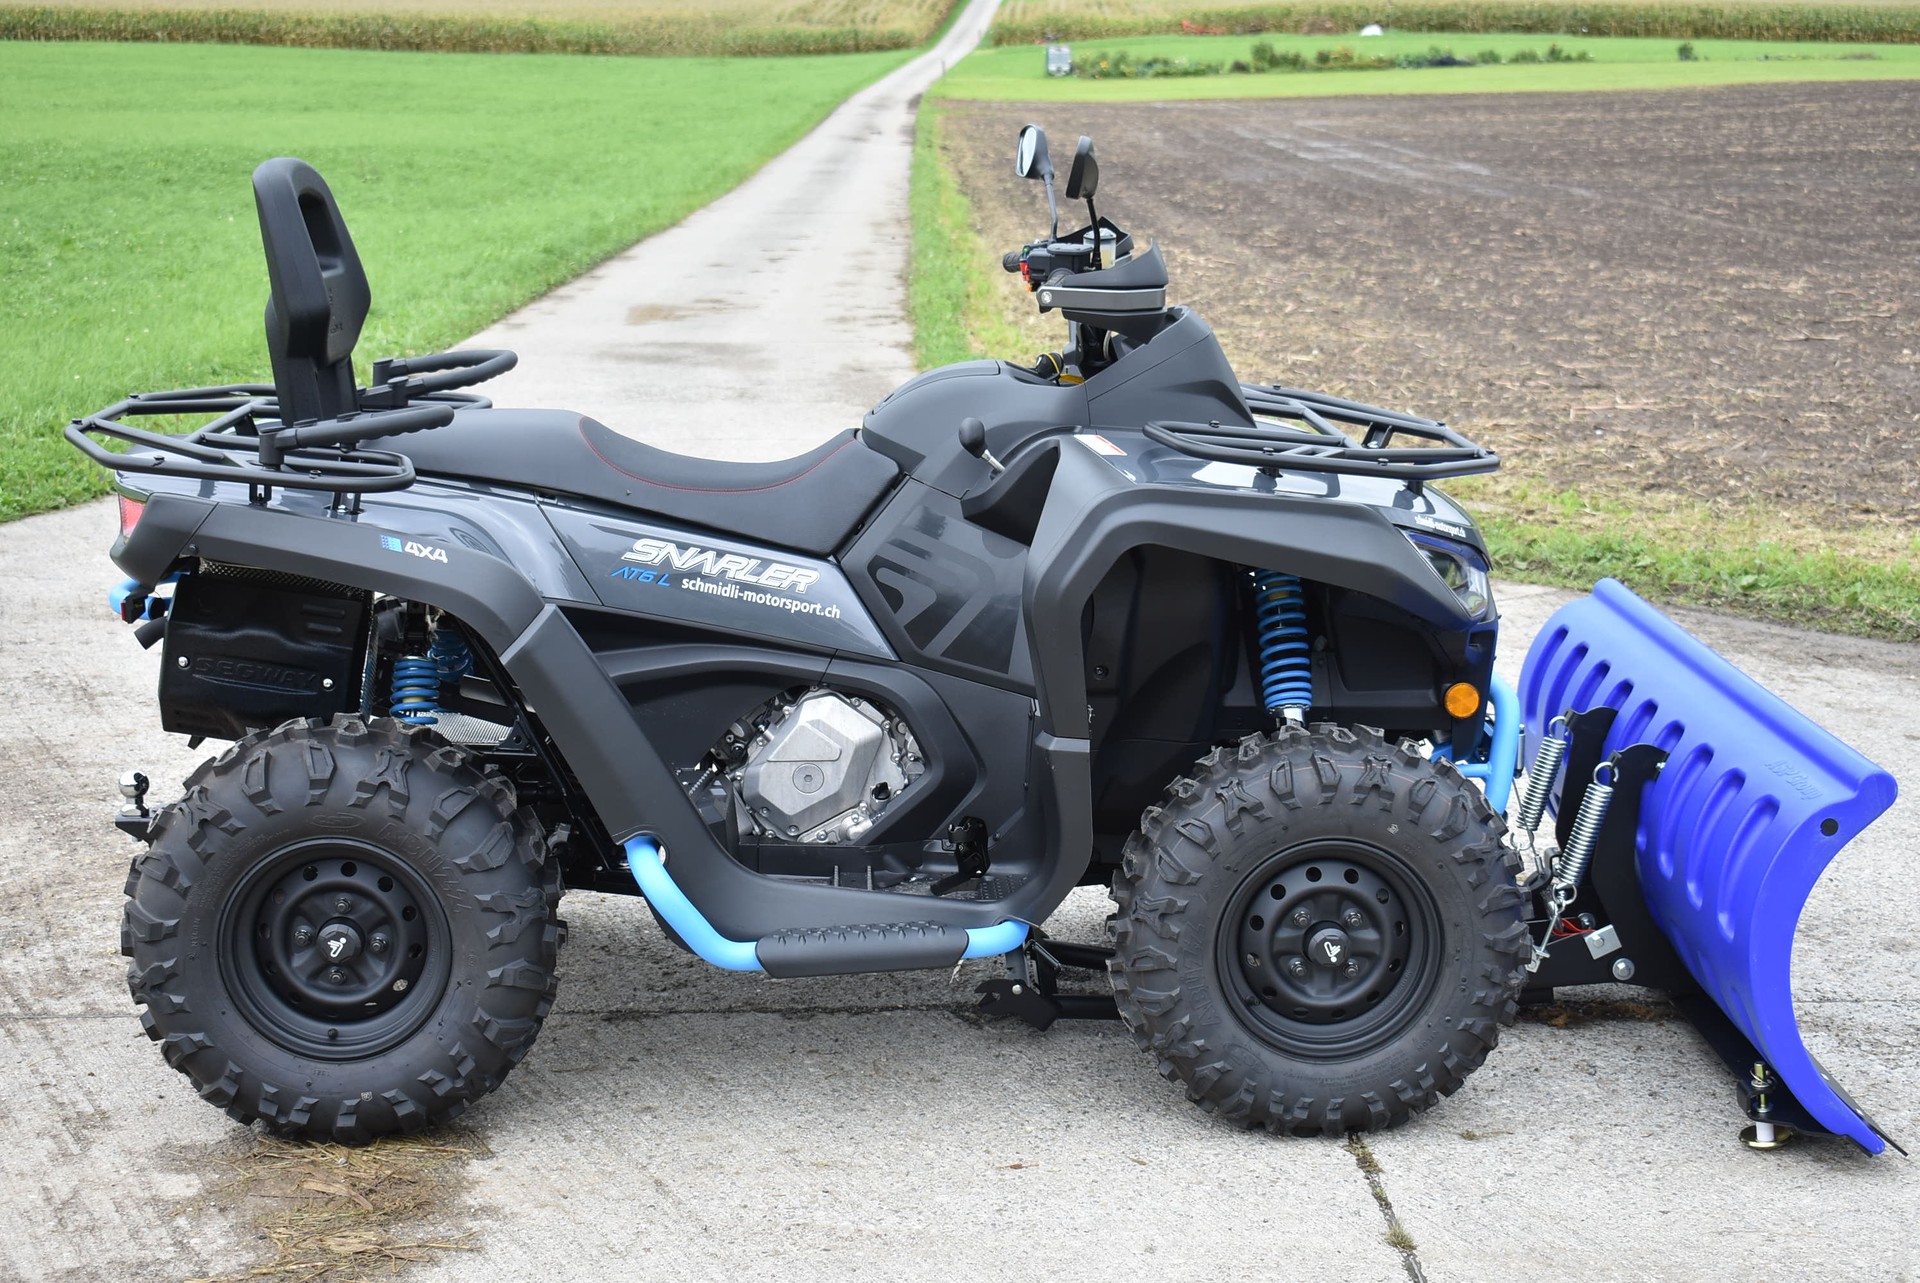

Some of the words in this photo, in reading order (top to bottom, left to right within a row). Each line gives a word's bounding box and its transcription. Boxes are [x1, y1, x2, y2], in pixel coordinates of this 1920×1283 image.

[404, 541, 449, 564] 4X4
[621, 538, 821, 594] SNARLER
[610, 566, 652, 583] AT6
[656, 573, 671, 587] L
[681, 577, 841, 619] schmidli-motorsport.ch
[195, 657, 318, 687] SEGWAY
